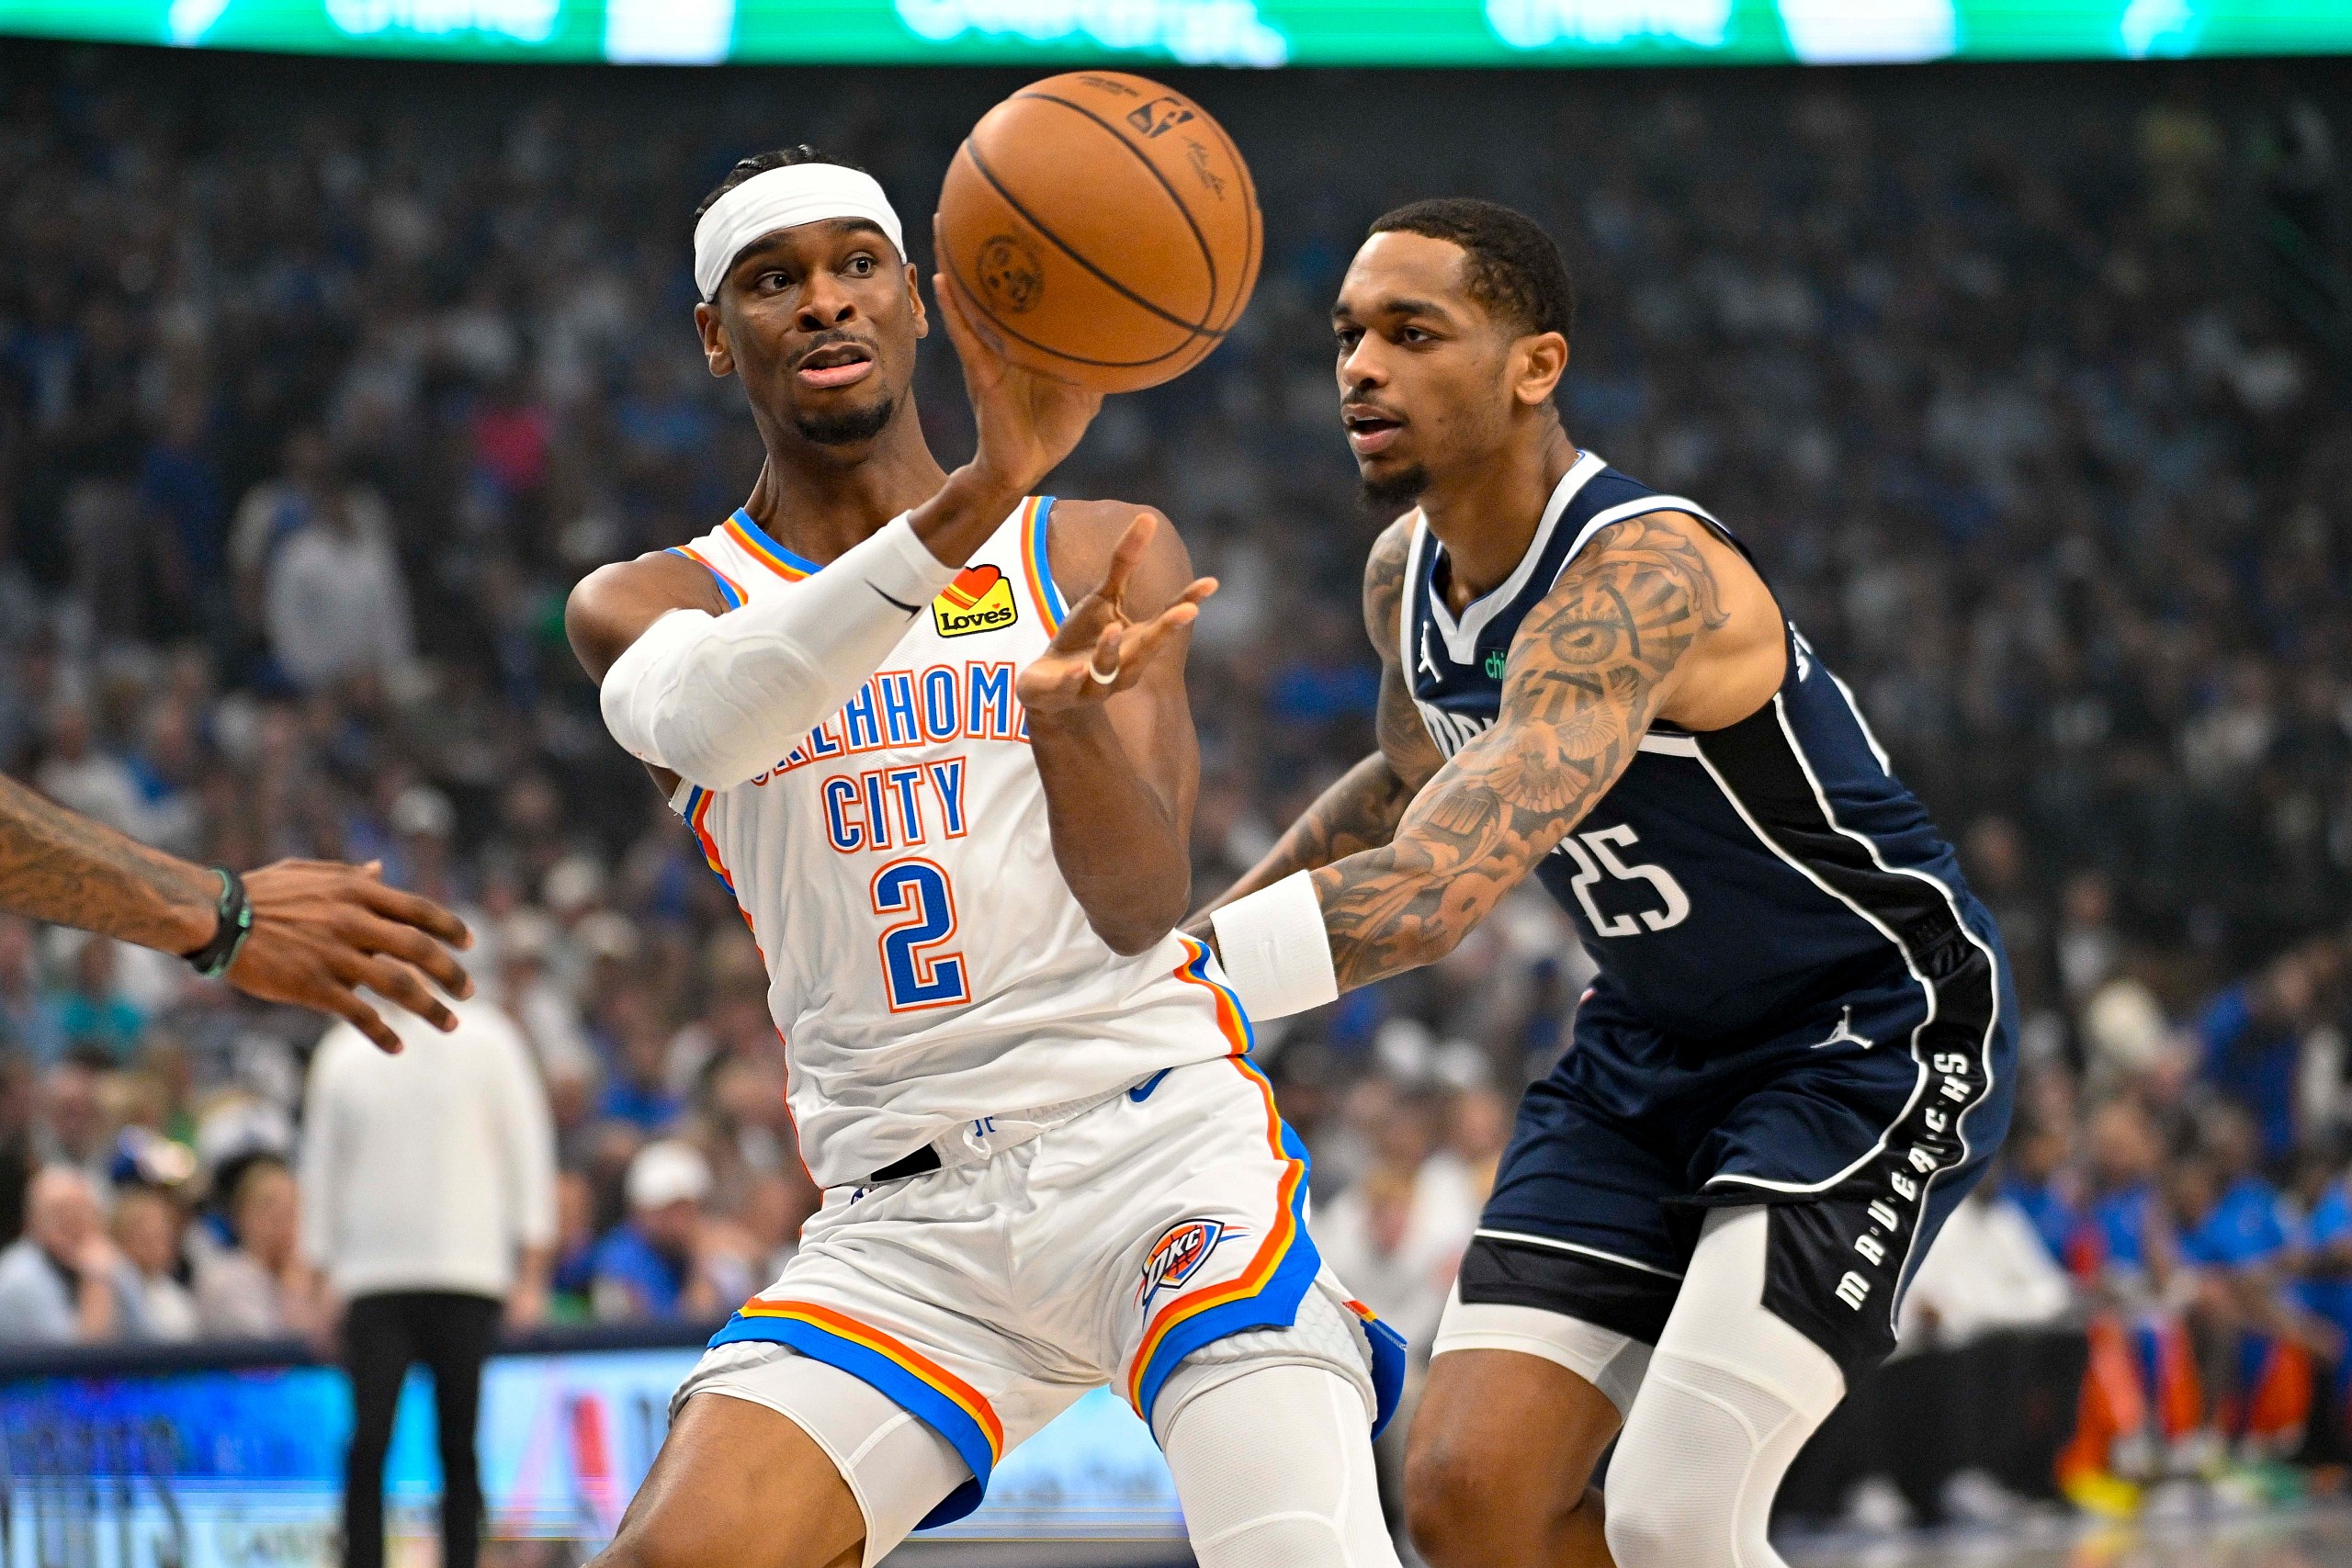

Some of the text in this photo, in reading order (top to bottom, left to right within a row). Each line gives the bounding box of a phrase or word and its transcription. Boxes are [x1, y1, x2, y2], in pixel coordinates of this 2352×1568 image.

[820, 755, 968, 854] CITY
[869, 856, 972, 1014] 2
[1551, 823, 1690, 938] 25
